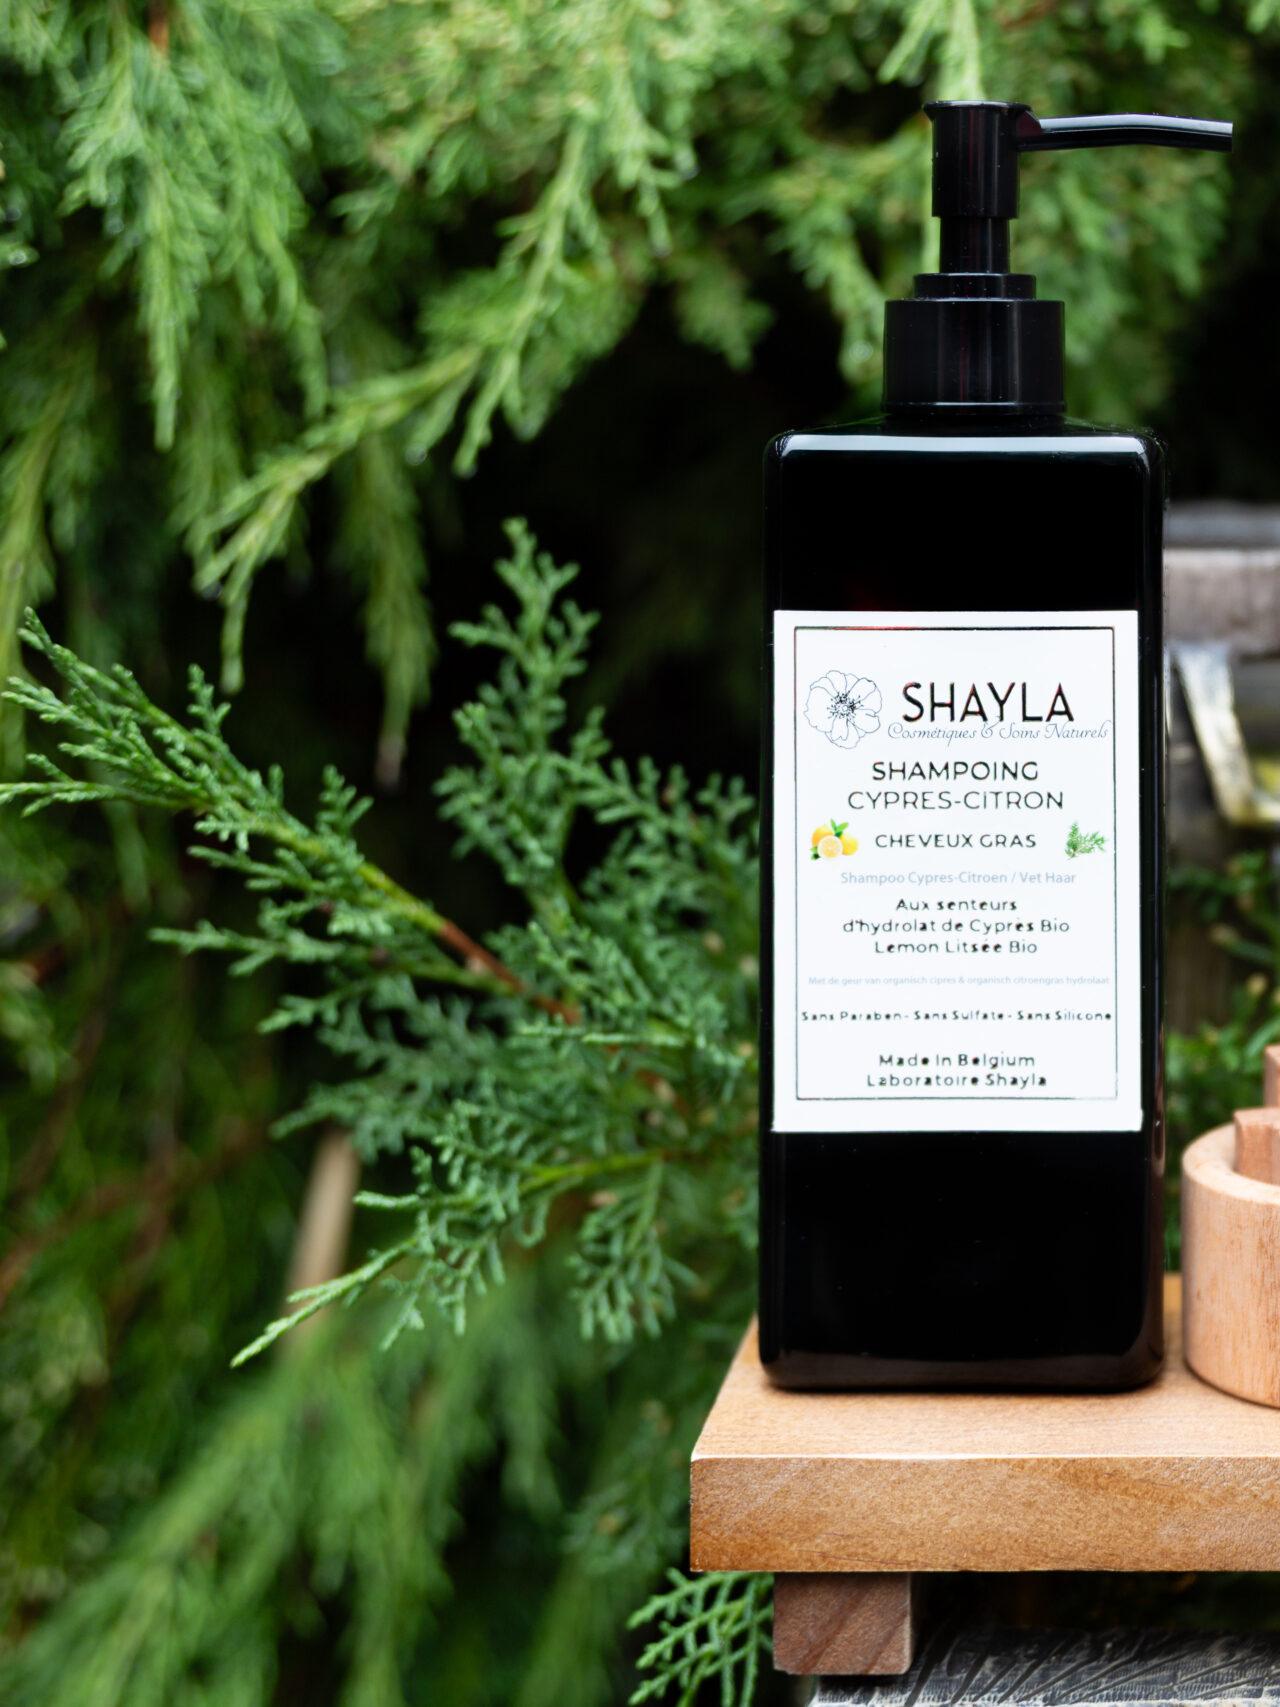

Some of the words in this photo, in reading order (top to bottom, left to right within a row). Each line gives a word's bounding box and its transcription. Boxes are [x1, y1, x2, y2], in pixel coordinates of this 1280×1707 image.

[903, 682, 1074, 722] SHAYLA
[981, 717, 1000, 739] &
[1000, 721, 1040, 739] Soins
[1044, 720, 1112, 739] Naturels
[872, 761, 1038, 781] SHAMPOING
[848, 791, 1064, 810] CYPRES-CITRON
[875, 834, 972, 849] CHEVEUX
[979, 834, 1037, 849] GRAS
[840, 872, 905, 886] Shampoo
[908, 872, 1008, 887] Cypres-Citroen
[1020, 872, 1042, 884] Vet
[1046, 872, 1077, 884] Haar
[896, 898, 930, 911] Aux
[936, 900, 1017, 911] senteurs
[942, 919, 963, 932] de
[1040, 918, 1069, 932] Bio
[875, 941, 939, 953] Lemon
[1008, 939, 1037, 953] Bio
[801, 1010, 834, 1021] Sans
[914, 1010, 947, 1021] Sans
[1017, 1010, 1050, 1021] Sans
[1055, 1009, 1112, 1021] Silicone
[879, 1054, 930, 1067] Made
[958, 1052, 1035, 1069] Belgium
[867, 1074, 979, 1087] Laboratoire
[985, 1073, 1047, 1089] Shayla
